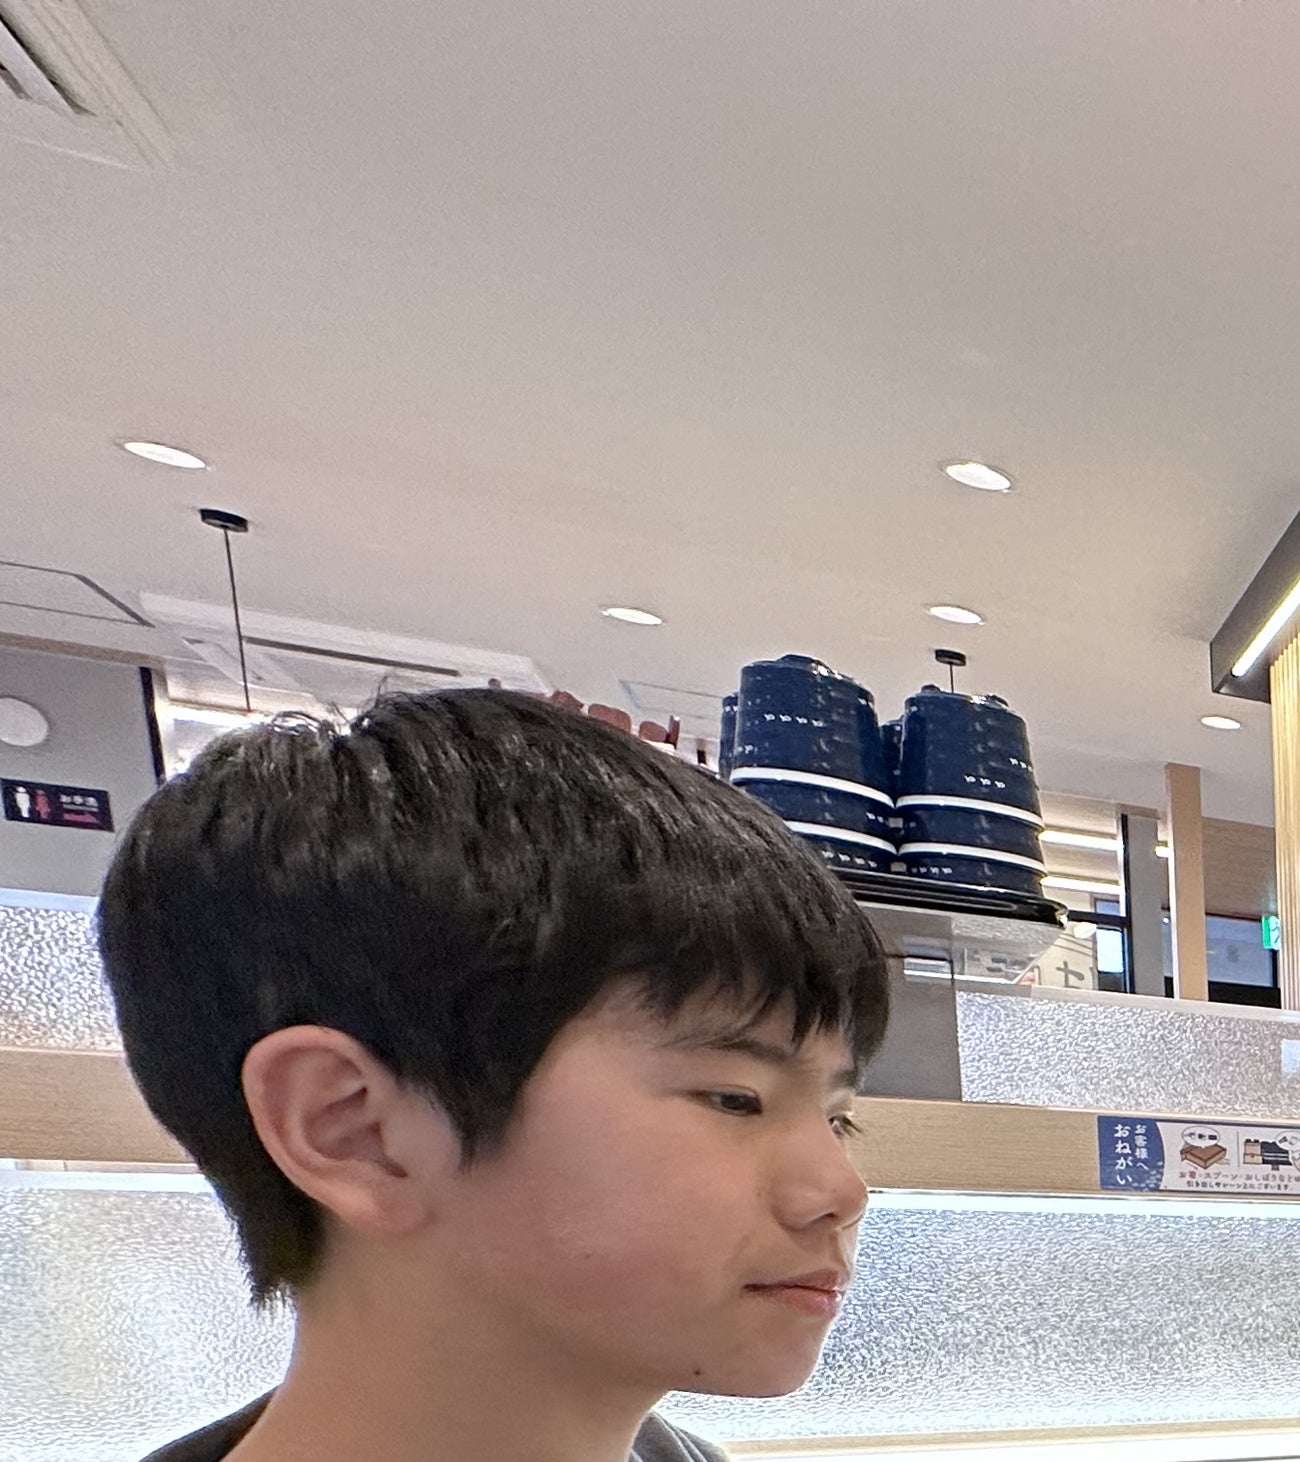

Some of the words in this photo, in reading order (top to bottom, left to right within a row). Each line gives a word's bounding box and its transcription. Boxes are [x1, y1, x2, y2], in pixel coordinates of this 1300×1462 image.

[1113, 1124, 1133, 1185] おねがい
[1134, 1124, 1149, 1171] お客様へ
